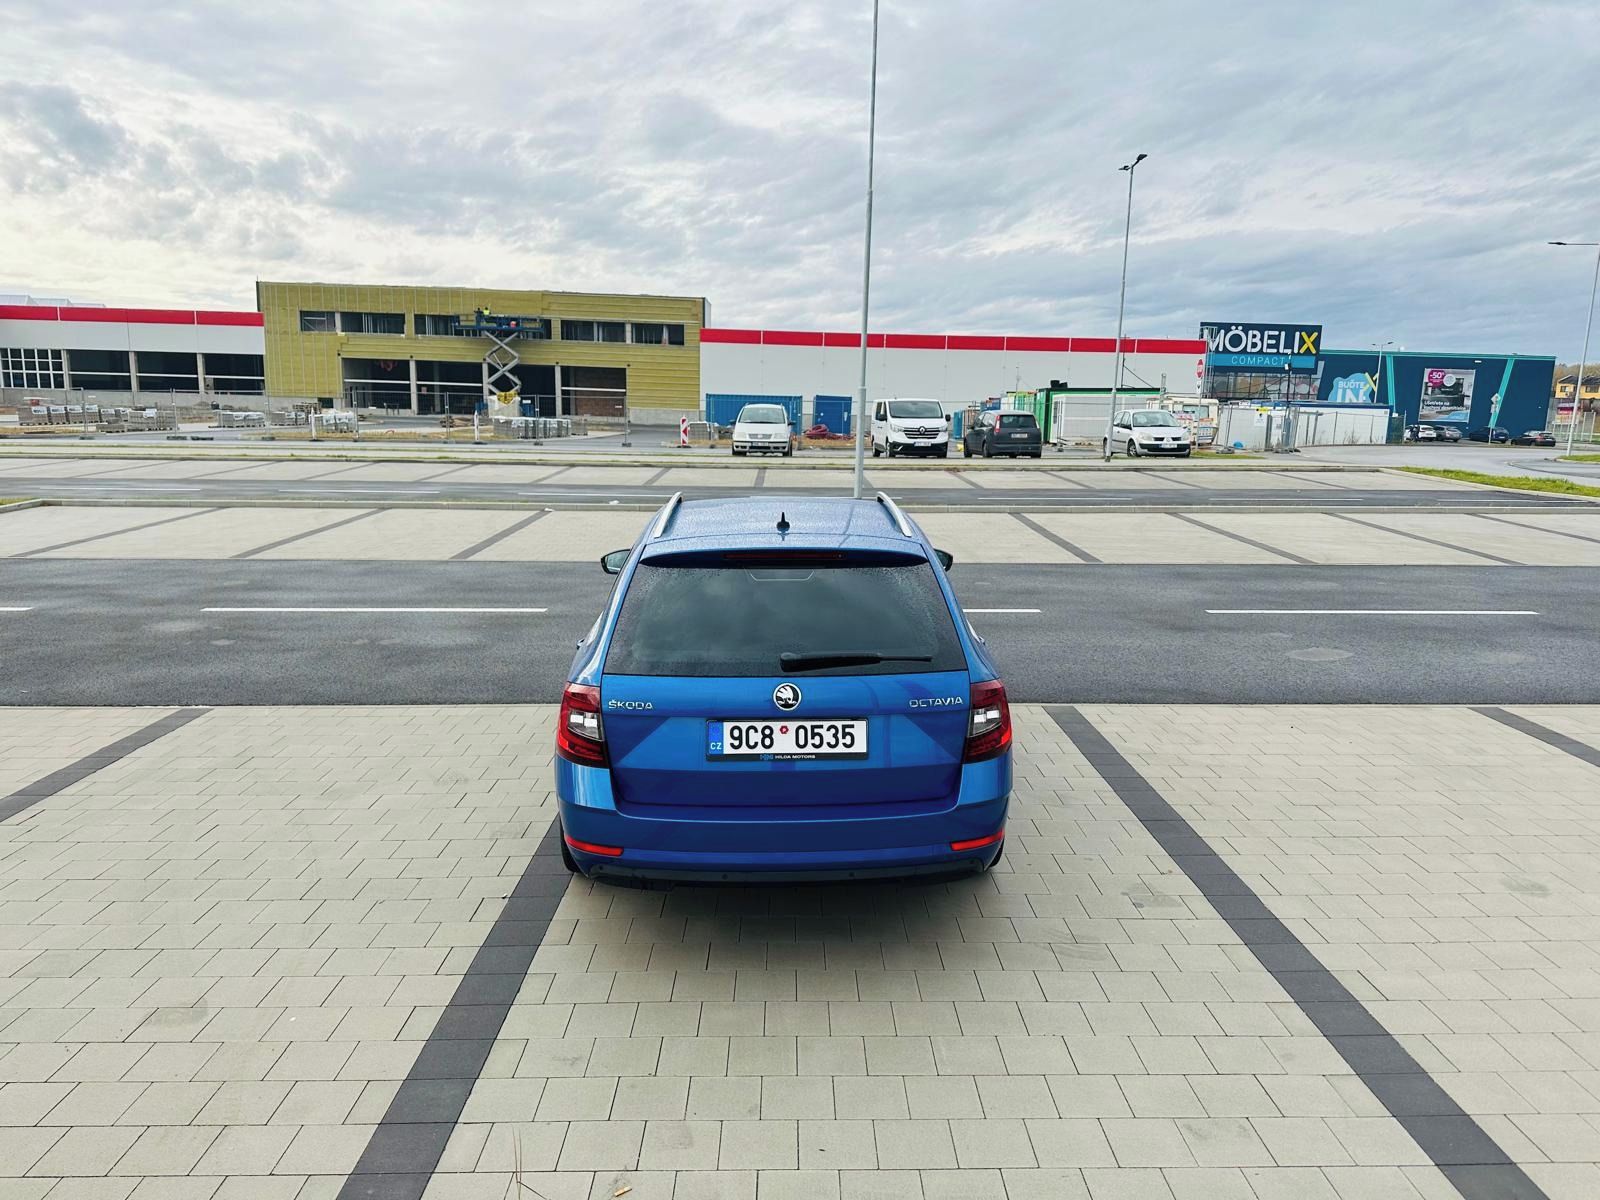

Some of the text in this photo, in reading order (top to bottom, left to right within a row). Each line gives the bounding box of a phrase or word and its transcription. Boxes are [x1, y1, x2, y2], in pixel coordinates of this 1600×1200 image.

[1202, 325, 1318, 354] MÖBELIX
[1231, 355, 1286, 366] COMPACT
[608, 699, 654, 710] ŠKODA
[909, 696, 964, 708] OCTAVIA
[729, 724, 856, 750] 9C8 0535
[710, 742, 722, 750] CZ
